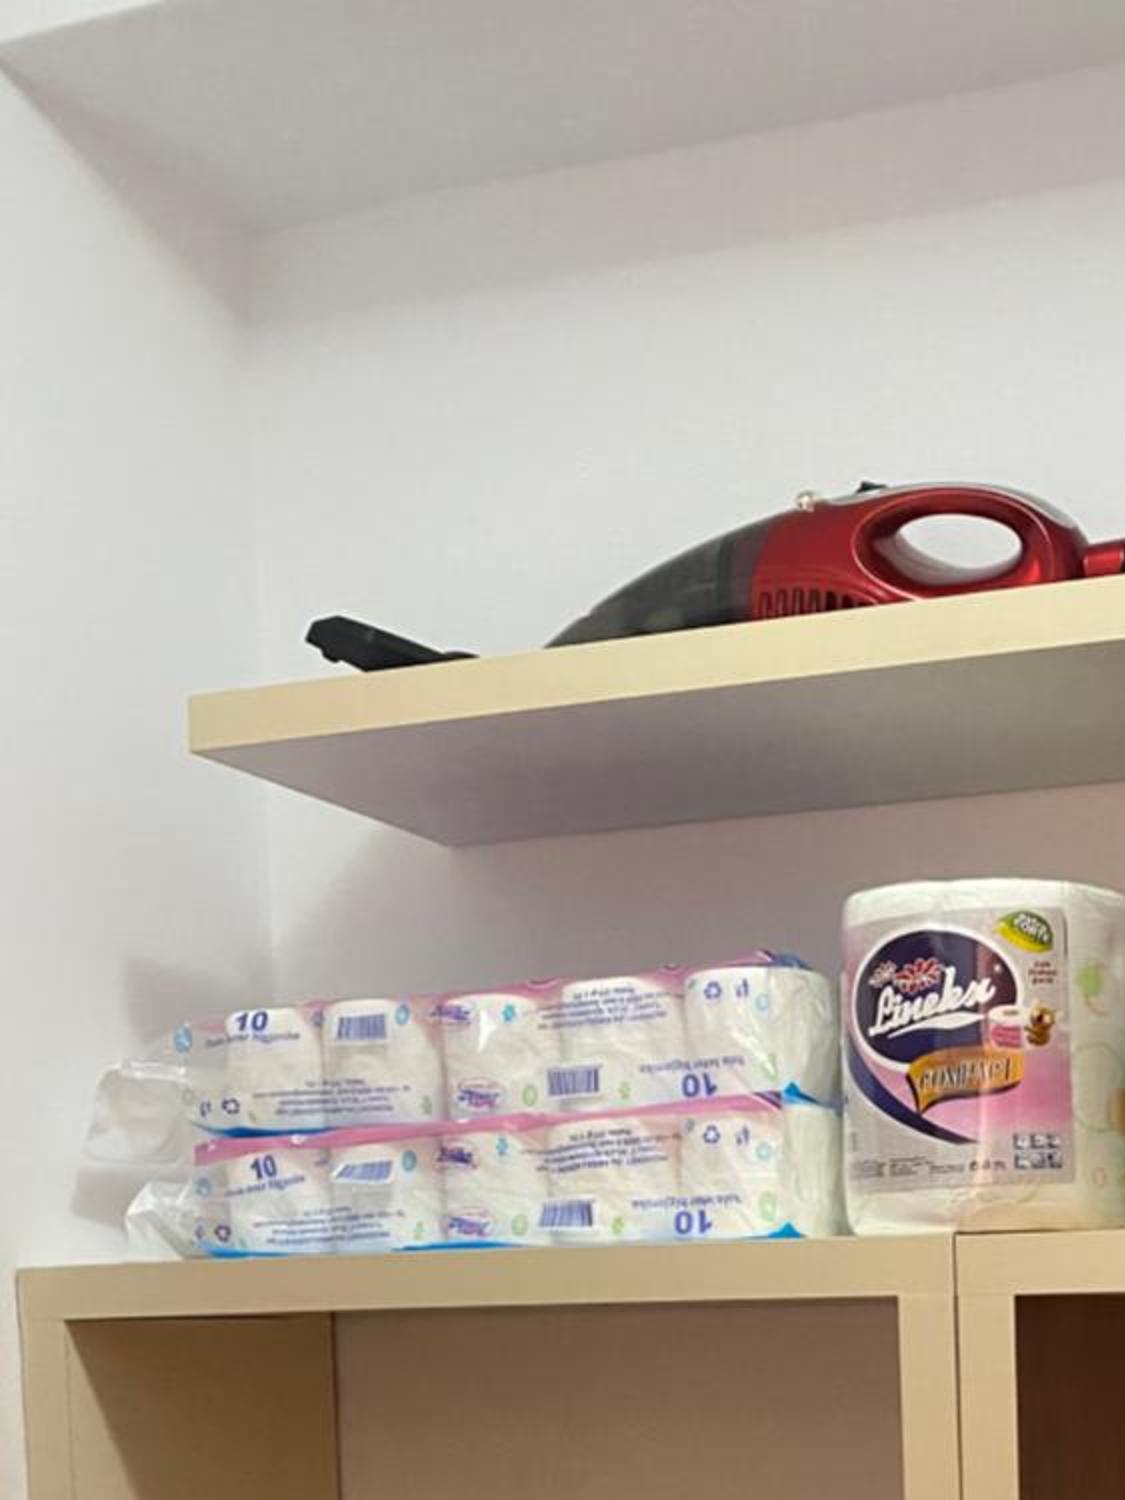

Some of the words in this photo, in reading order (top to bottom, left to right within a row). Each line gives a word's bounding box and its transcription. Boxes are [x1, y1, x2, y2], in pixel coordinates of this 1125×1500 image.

[234, 1010, 268, 1032] 10
[682, 1072, 718, 1098] 10
[250, 1154, 278, 1180] 10
[674, 1208, 713, 1235] 10
